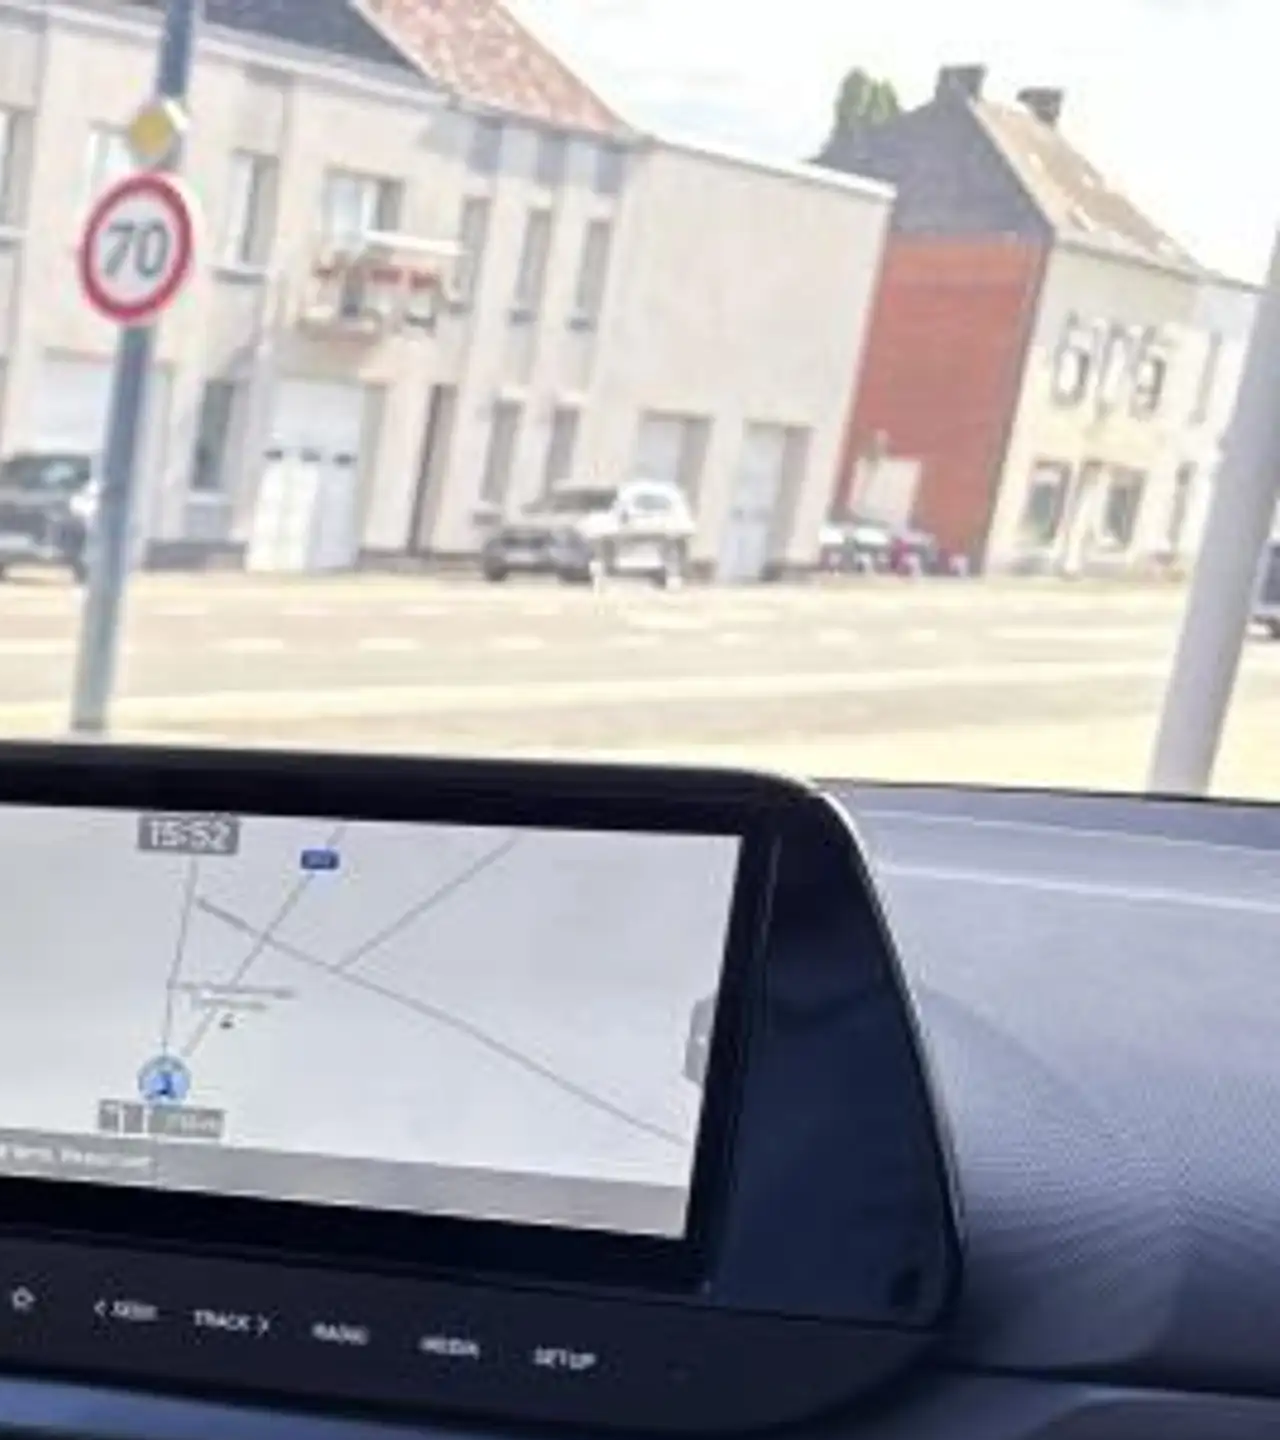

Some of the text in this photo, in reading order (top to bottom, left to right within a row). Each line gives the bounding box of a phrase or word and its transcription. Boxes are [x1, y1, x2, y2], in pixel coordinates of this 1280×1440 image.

[102, 217, 171, 282] 70
[150, 818, 232, 851] 15:52
[192, 1308, 252, 1333] TRACK
[533, 1346, 598, 1371] SETUP
